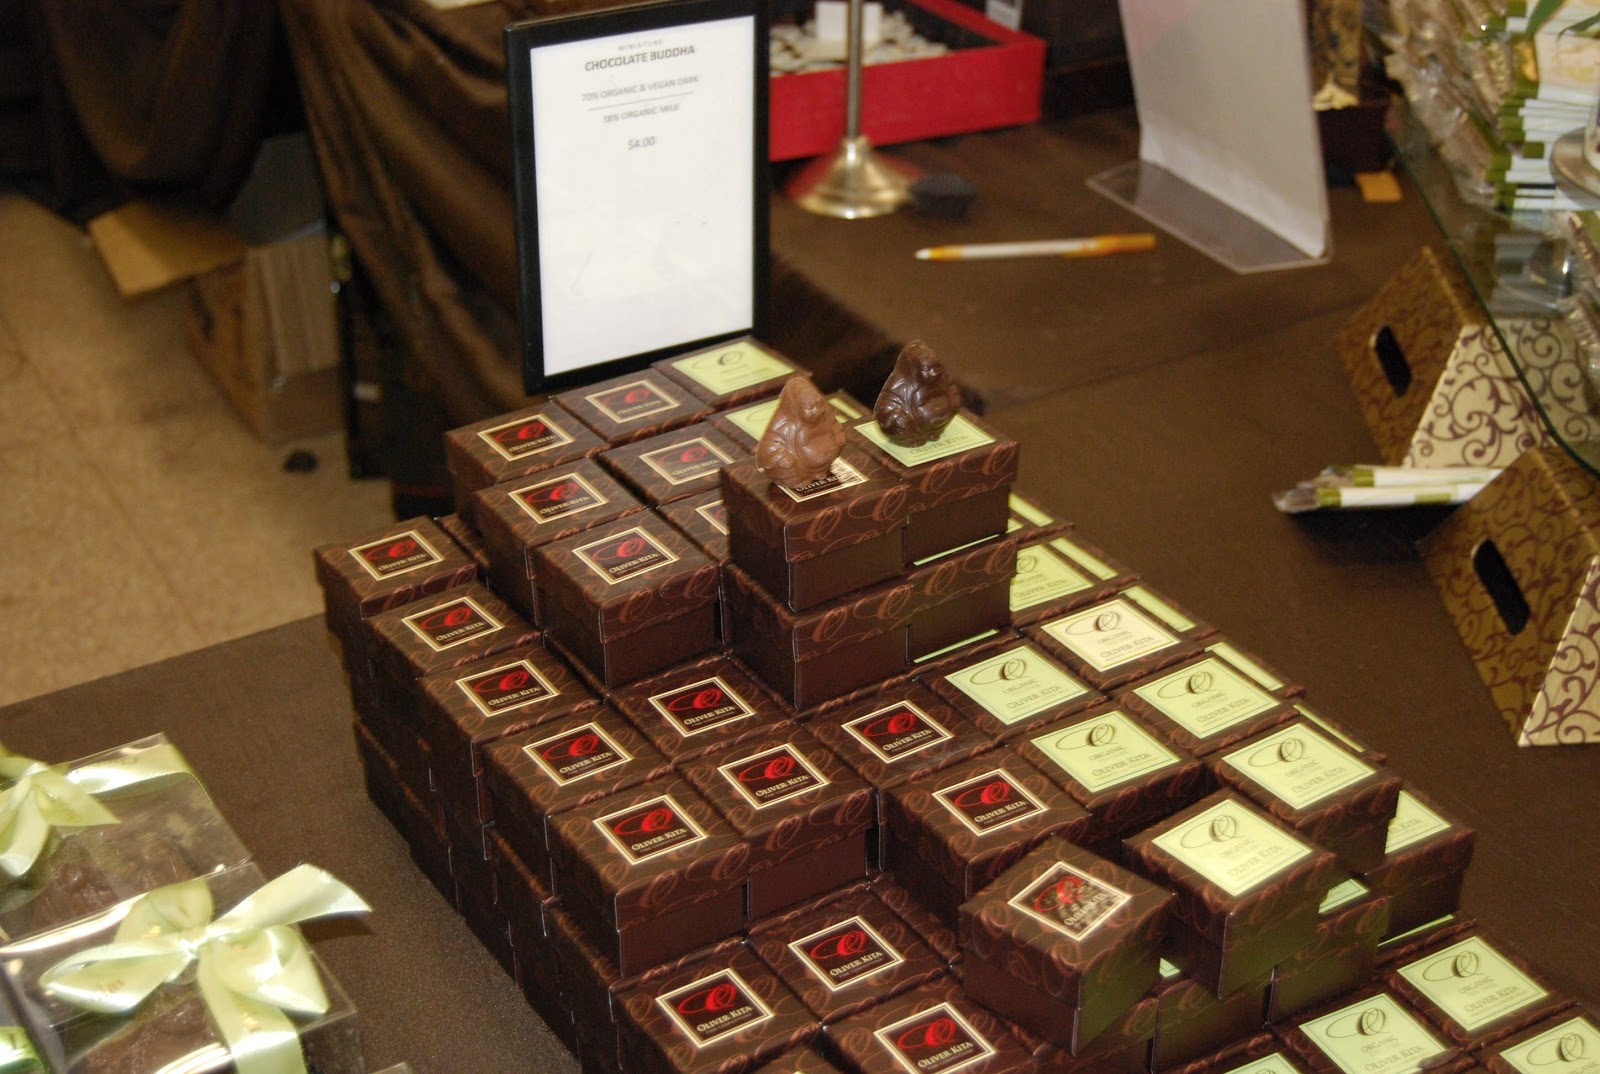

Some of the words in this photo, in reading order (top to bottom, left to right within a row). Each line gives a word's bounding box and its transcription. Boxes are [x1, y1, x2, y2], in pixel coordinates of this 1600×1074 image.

[585, 52, 647, 71] CHOCOLATE
[650, 46, 695, 61] BUDDHA
[600, 86, 637, 98] ORGANIC
[647, 80, 675, 90] VEGAN
[677, 76, 699, 85] DARK
[621, 107, 658, 119] ORGANIC
[627, 136, 655, 150] $4.00
[540, 502, 570, 514] OLIVER
[378, 559, 407, 570] OLIVER
[609, 560, 639, 573] OLIVER
[638, 553, 658, 563] KITA
[436, 629, 465, 641] OLIVER
[464, 622, 485, 631] KITA
[488, 694, 519, 706] OLIVER
[520, 688, 540, 696] KITA
[1007, 694, 1041, 709] OLIVER
[1040, 685, 1061, 695] KITA
[684, 712, 715, 725] OLIVER
[715, 706, 735, 716] KITA
[882, 737, 913, 751] OLIVER
[911, 730, 932, 739] KITA
[560, 759, 591, 774] OLIVER
[591, 752, 612, 762] KITA
[1089, 745, 1127, 760] ORGANIC
[1092, 761, 1128, 776] OLIVER
[1127, 752, 1150, 763] KITA
[756, 781, 788, 796] OLIVER
[788, 775, 809, 785] KITA
[1291, 777, 1325, 793] OLIVER
[1324, 768, 1346, 777] KITA
[974, 808, 1006, 823] OLIVER
[1005, 801, 1026, 811] KITA
[631, 835, 665, 850] OLIVER
[665, 828, 687, 839] KITA
[830, 958, 862, 976] OLIVER
[861, 952, 882, 963] KITA
[1464, 994, 1499, 1012] OLIVER
[1496, 986, 1519, 997] KITA
[697, 1014, 730, 1032] OLIVER
[730, 1006, 752, 1018] KITA
[918, 1050, 951, 1068] OLIVER
[950, 1042, 973, 1053] KITA
[1360, 1036, 1398, 1052] ORGANIC
[1364, 1054, 1400, 1071] OLIVER
[1401, 1046, 1423, 1057] KITA
